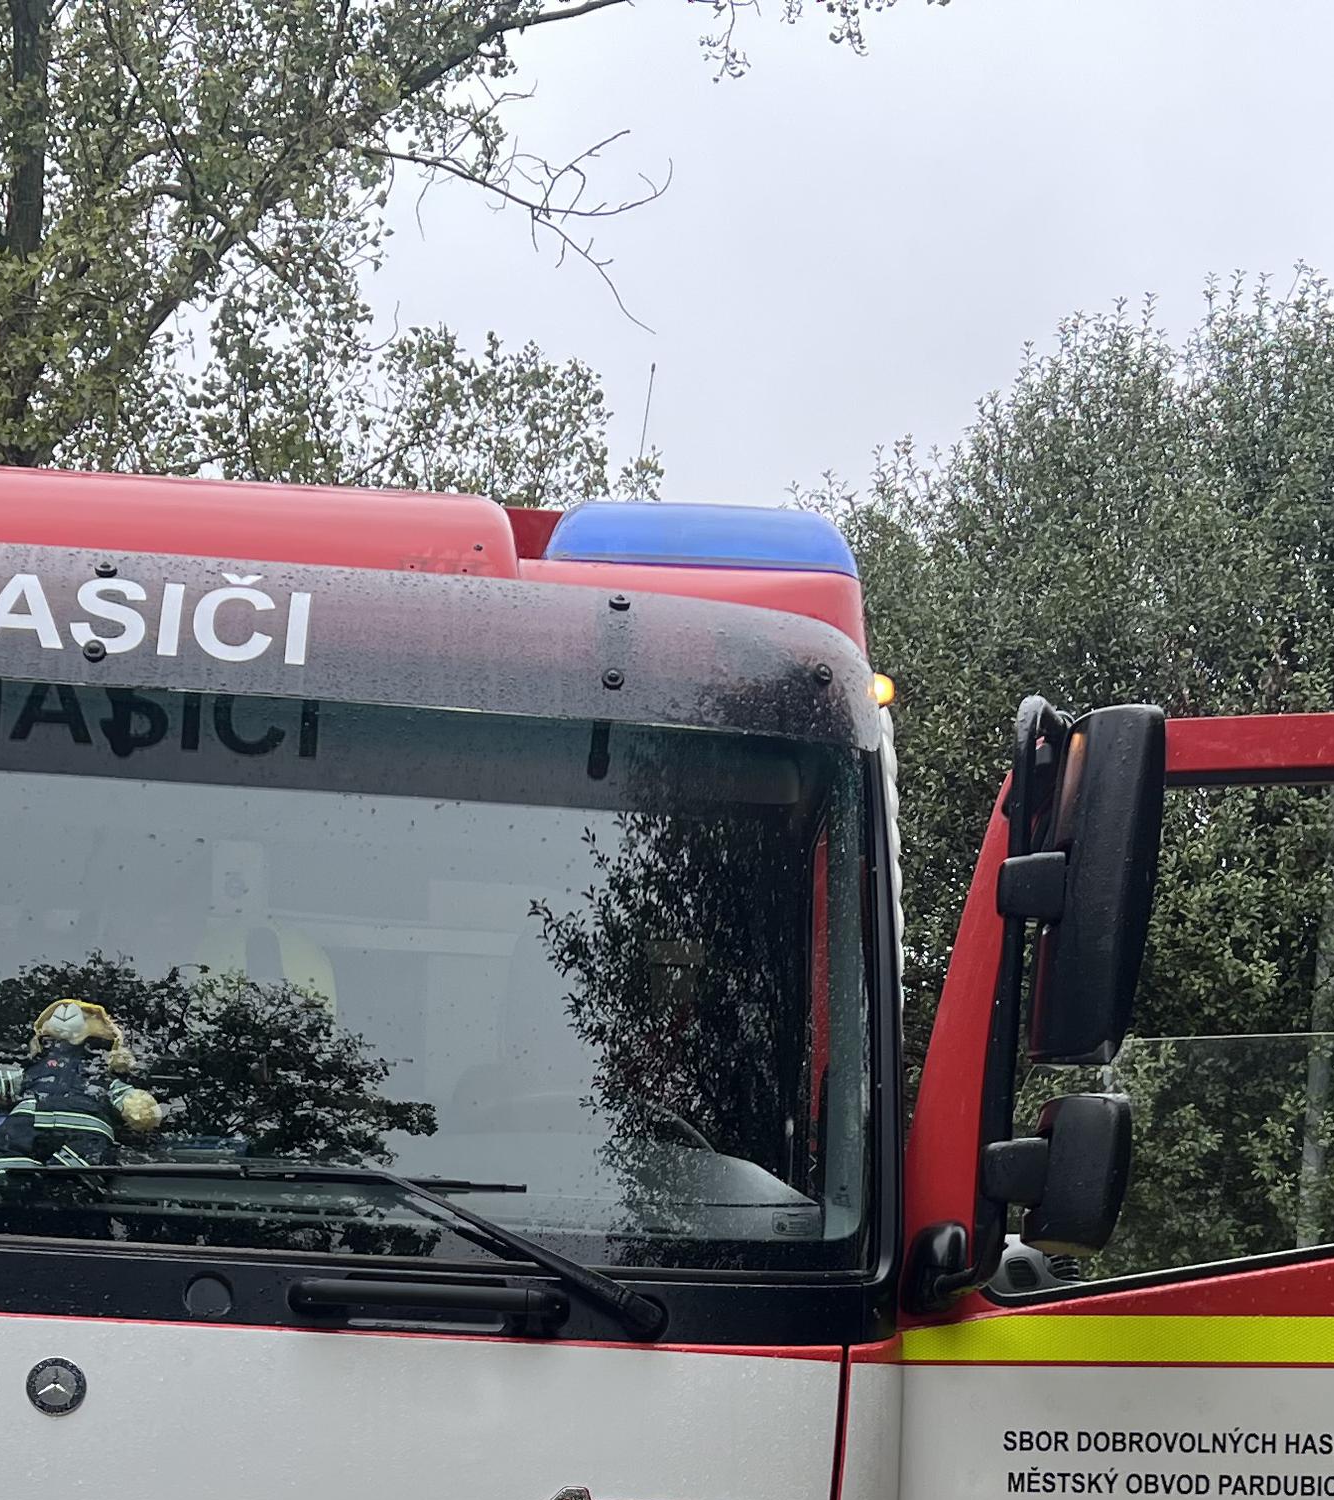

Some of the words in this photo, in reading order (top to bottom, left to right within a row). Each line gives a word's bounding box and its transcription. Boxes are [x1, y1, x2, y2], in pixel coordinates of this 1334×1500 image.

[1003, 1430, 1069, 1452] SBOR
[1077, 1427, 1277, 1455] DOBROVOLNÝCH
[1007, 1466, 1119, 1494] MĚSTSKÝ
[1125, 1473, 1210, 1495] OBVOD
